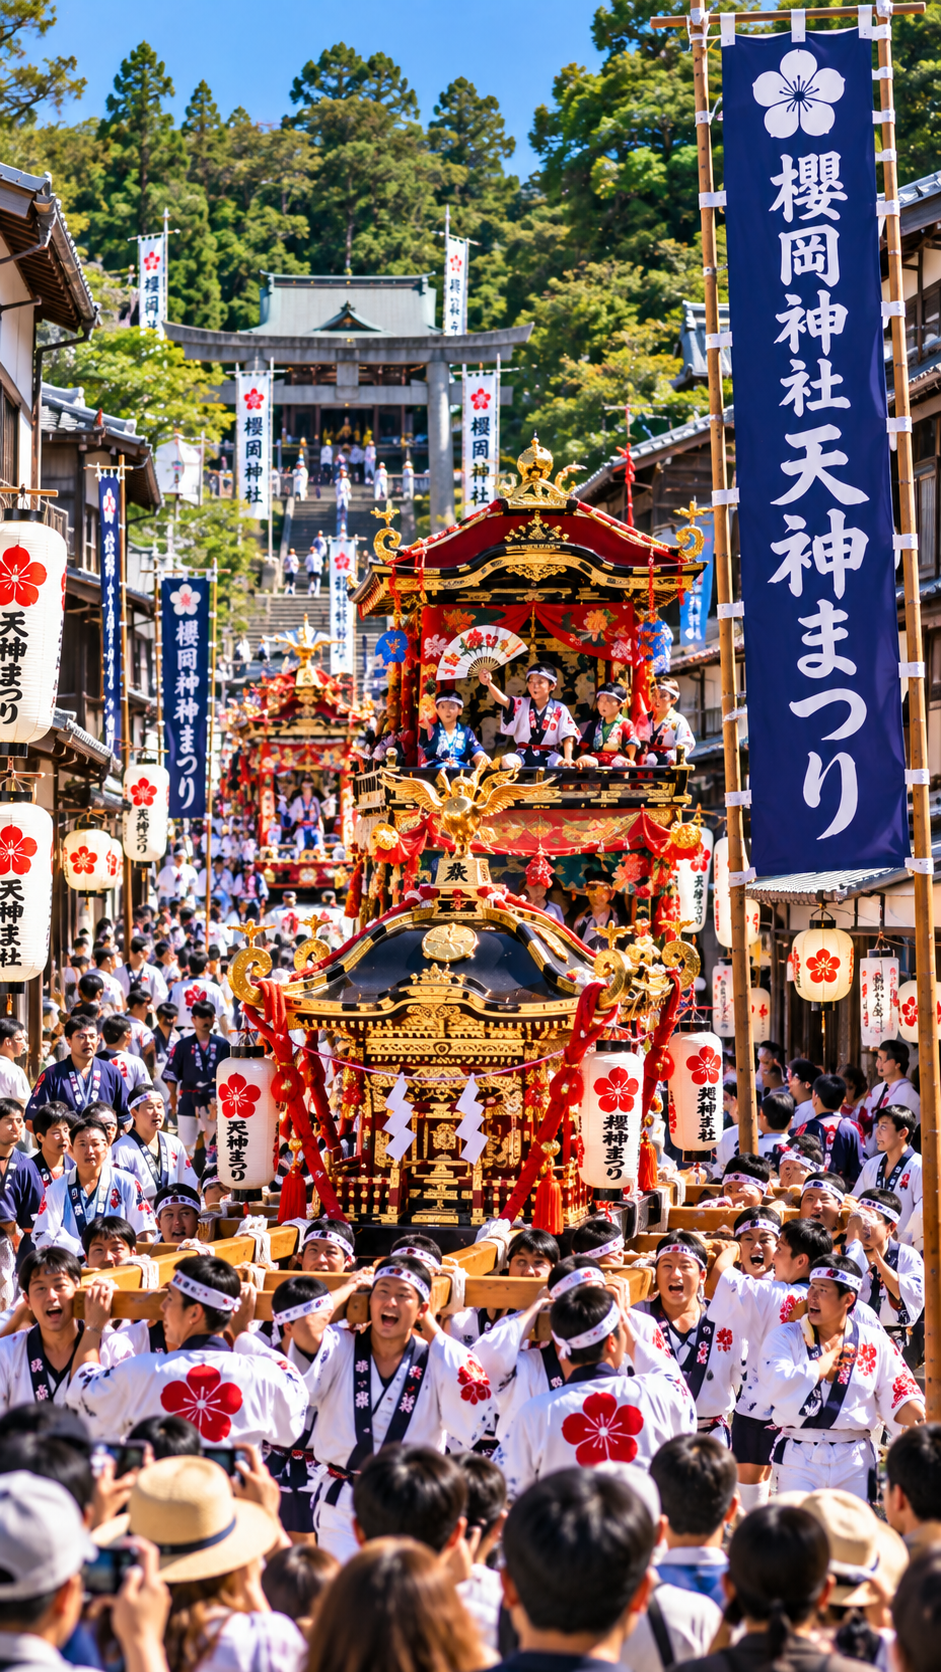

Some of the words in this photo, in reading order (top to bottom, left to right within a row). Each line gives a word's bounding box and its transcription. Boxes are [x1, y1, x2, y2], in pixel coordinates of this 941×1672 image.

[769, 152, 870, 841] 櫻岡神社天神まつり
[0, 611, 29, 725] 天神まつり
[173, 620, 200, 810] 櫻岡神神まつり
[226, 1120, 249, 1182] 天神まつり
